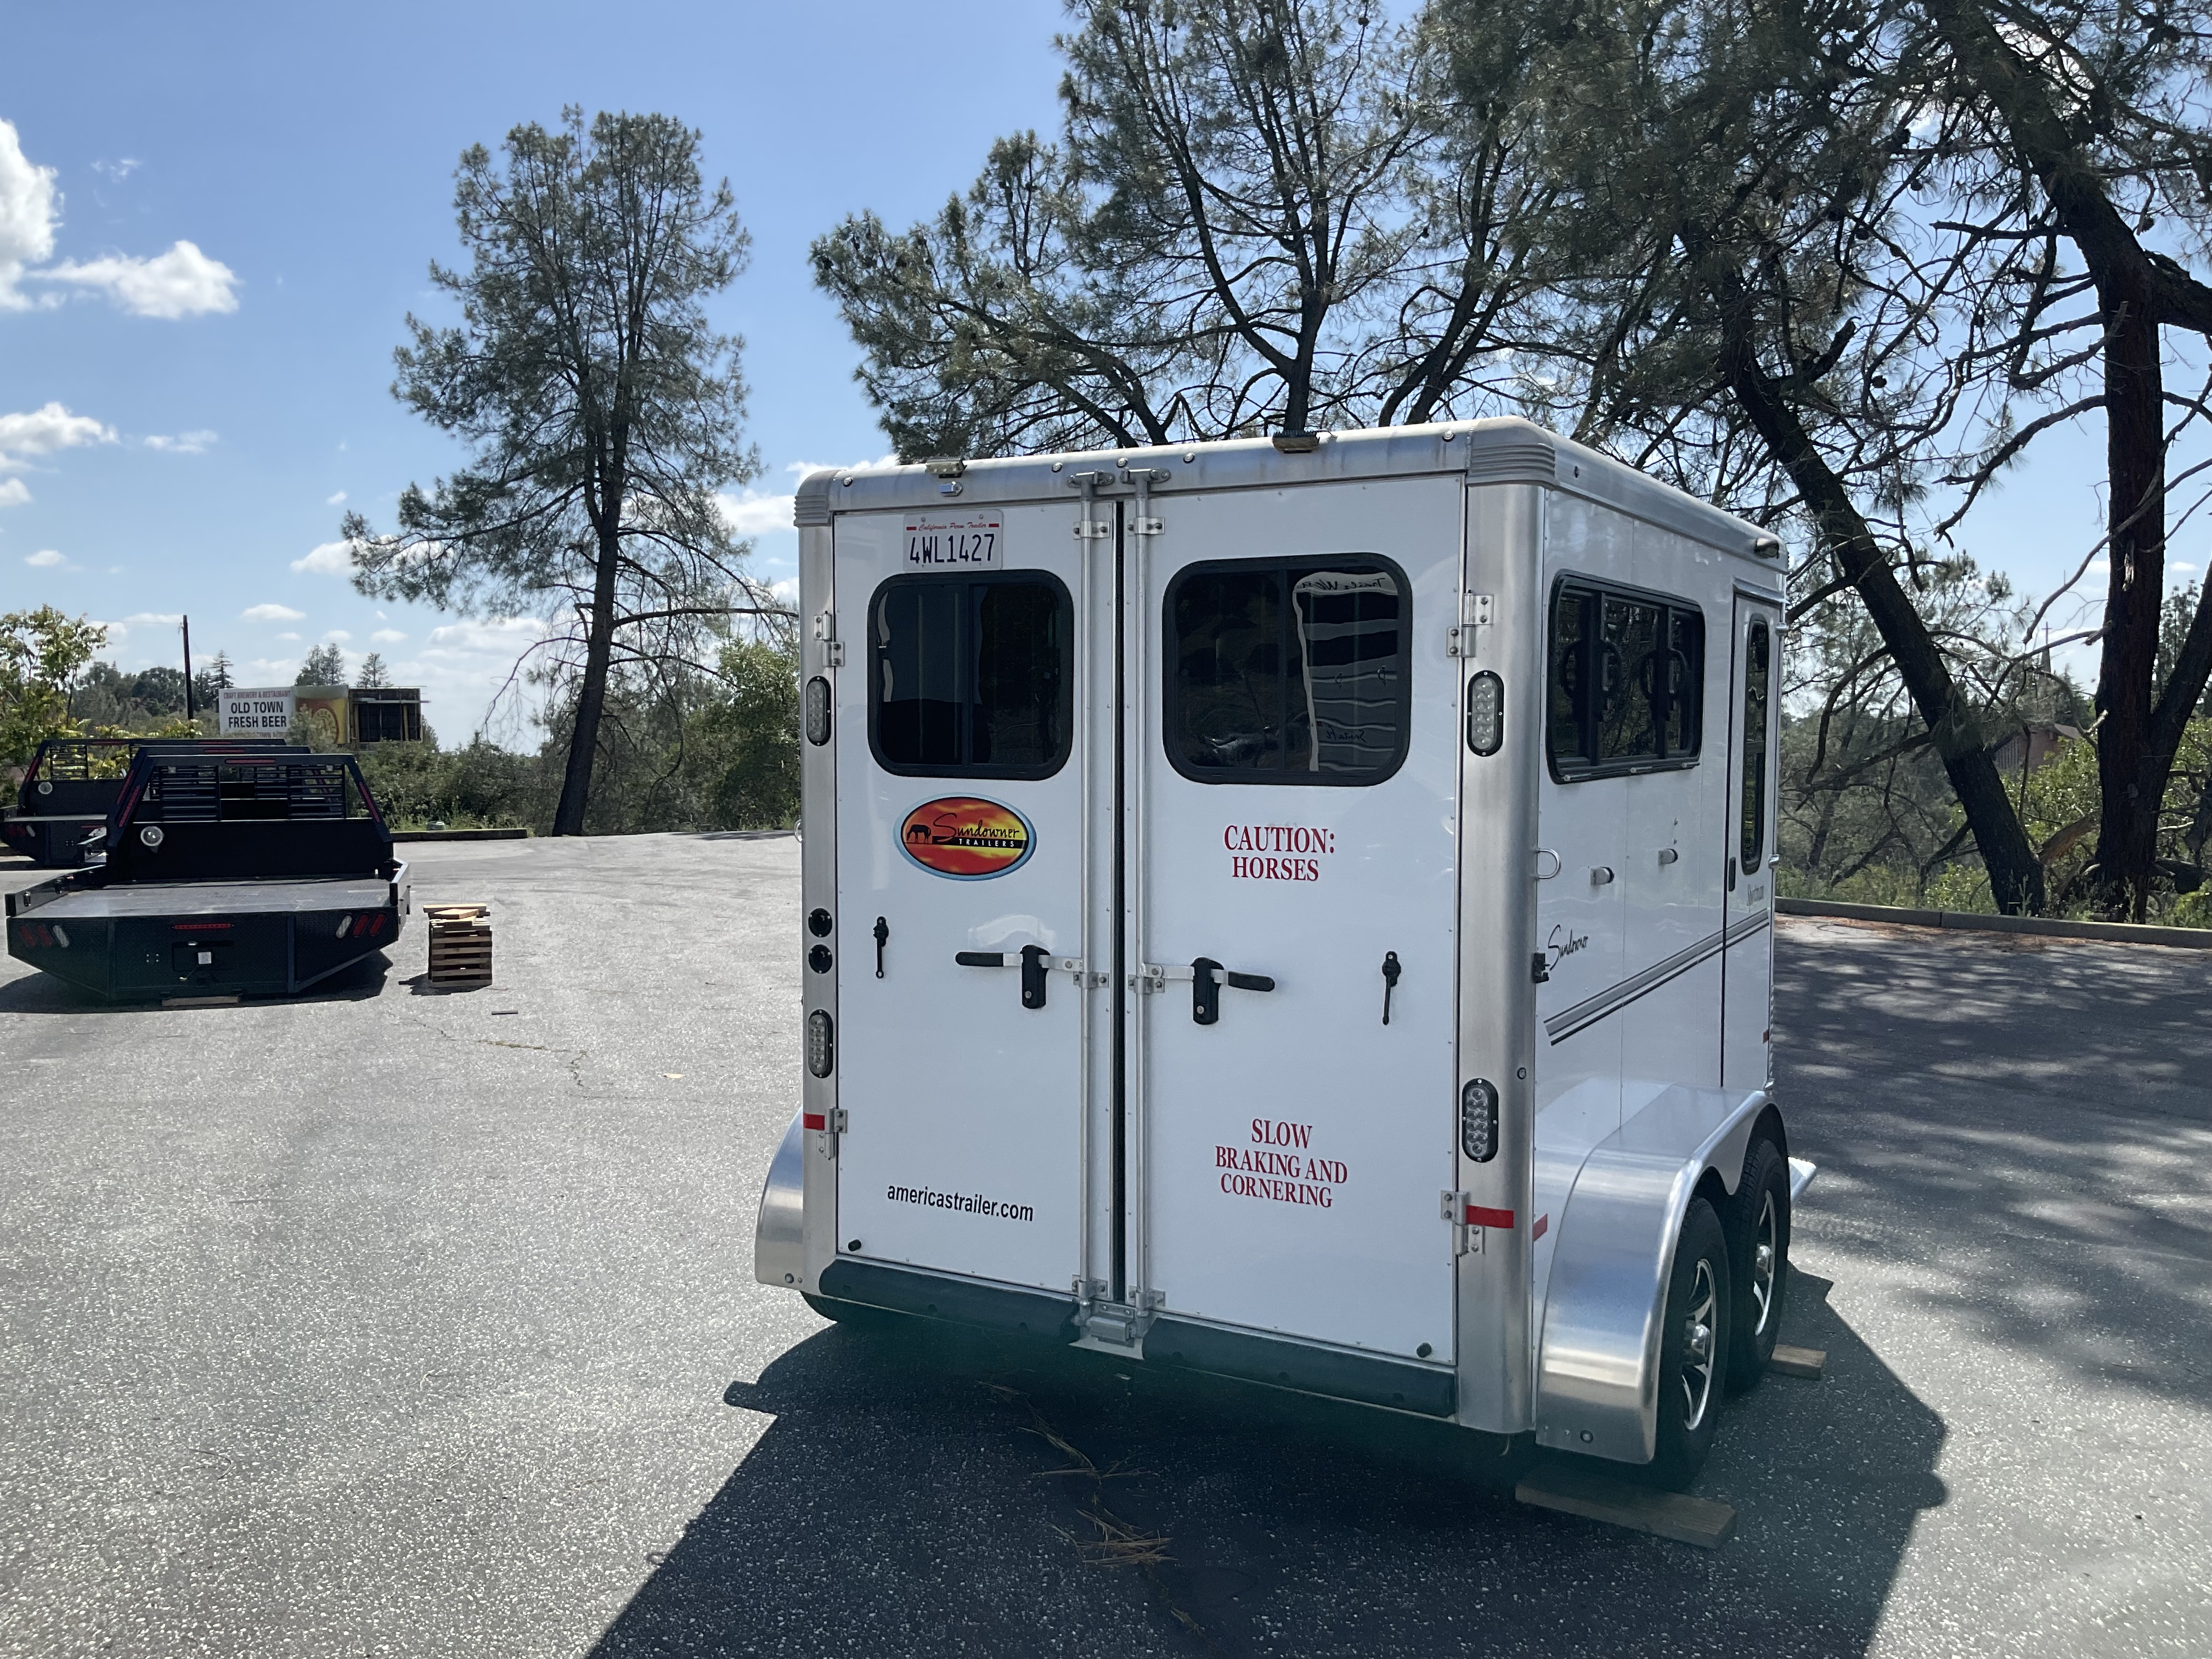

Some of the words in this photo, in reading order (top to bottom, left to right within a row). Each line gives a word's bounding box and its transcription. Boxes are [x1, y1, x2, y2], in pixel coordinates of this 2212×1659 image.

[918, 524, 947, 532] California
[910, 533, 995, 563] 4WL1427
[230, 702, 250, 714] OLD
[253, 701, 283, 714] TOWN
[237, 691, 257, 699] BREWERY
[262, 690, 291, 698] RESTAURANT
[228, 716, 258, 728] FRESH
[262, 715, 287, 728] BEER
[933, 812, 1020, 842] Sundowner
[1224, 825, 1335, 854] CAUTION:
[959, 836, 1014, 848] TRAILERS
[1232, 856, 1319, 882] HORSES
[1251, 1119, 1313, 1149] SLOW
[1215, 1145, 1301, 1178] BRAKING
[1305, 1158, 1348, 1184] AND
[887, 1185, 1034, 1222] americastrailer.com
[1221, 1173, 1333, 1208] CORNERING
